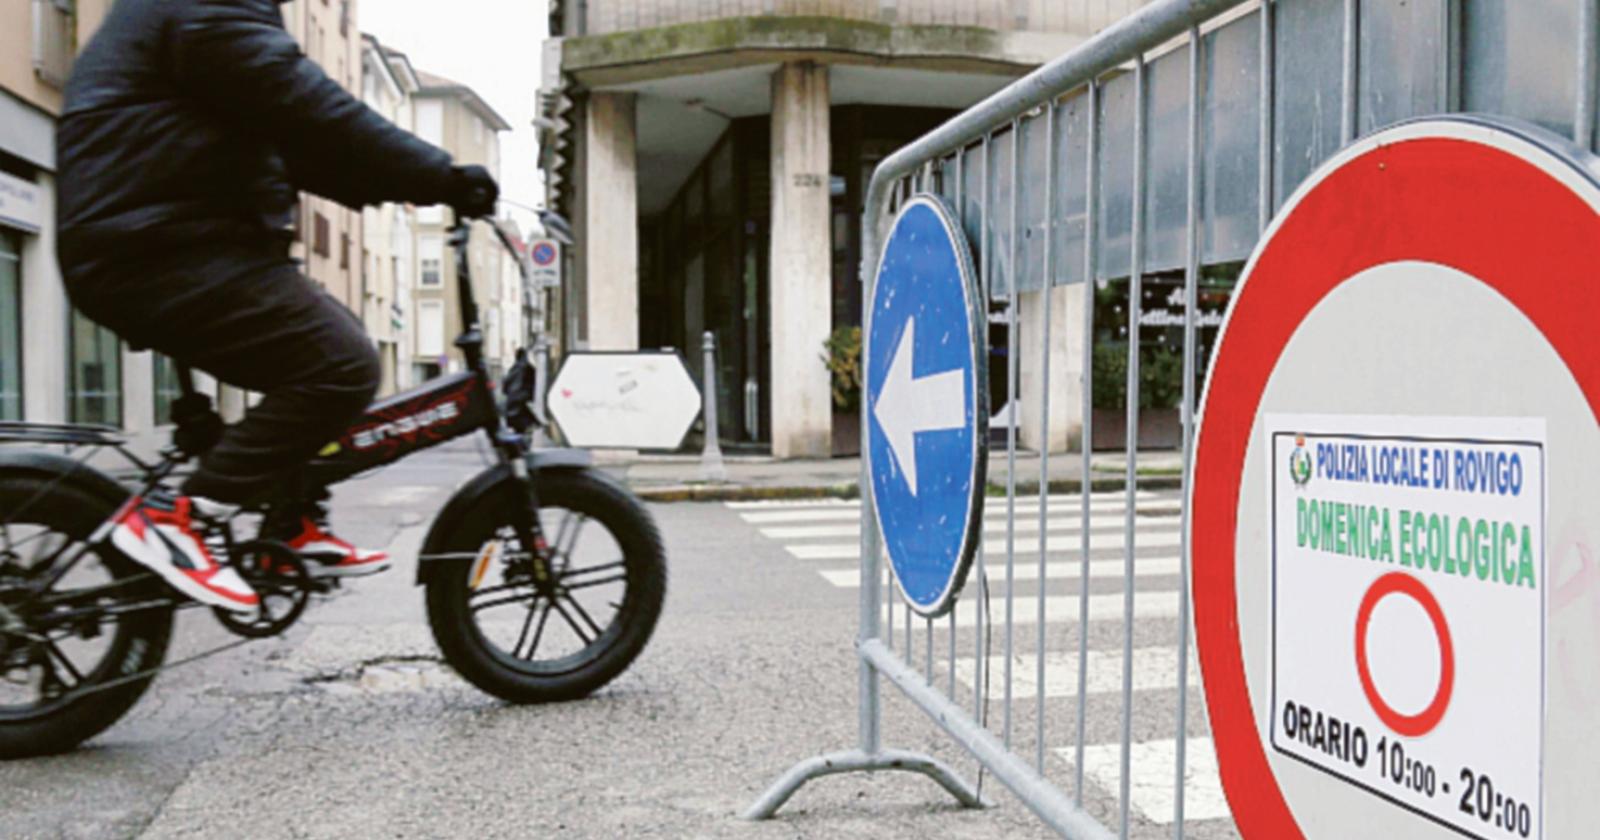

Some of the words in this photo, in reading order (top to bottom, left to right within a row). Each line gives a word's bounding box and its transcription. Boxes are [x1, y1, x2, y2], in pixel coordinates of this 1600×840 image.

[1317, 443, 1369, 482] POLIZIA
[1373, 446, 1428, 488] LOCALE
[1433, 449, 1450, 490] DI
[1455, 450, 1523, 496] ROVIGO
[1297, 497, 1394, 563] DOMENICA
[1399, 510, 1536, 589] ECOLOGICA
[1283, 700, 1368, 768] ORARIO
[1377, 736, 1436, 798] 10:00
[1459, 767, 1531, 838] 20:00
